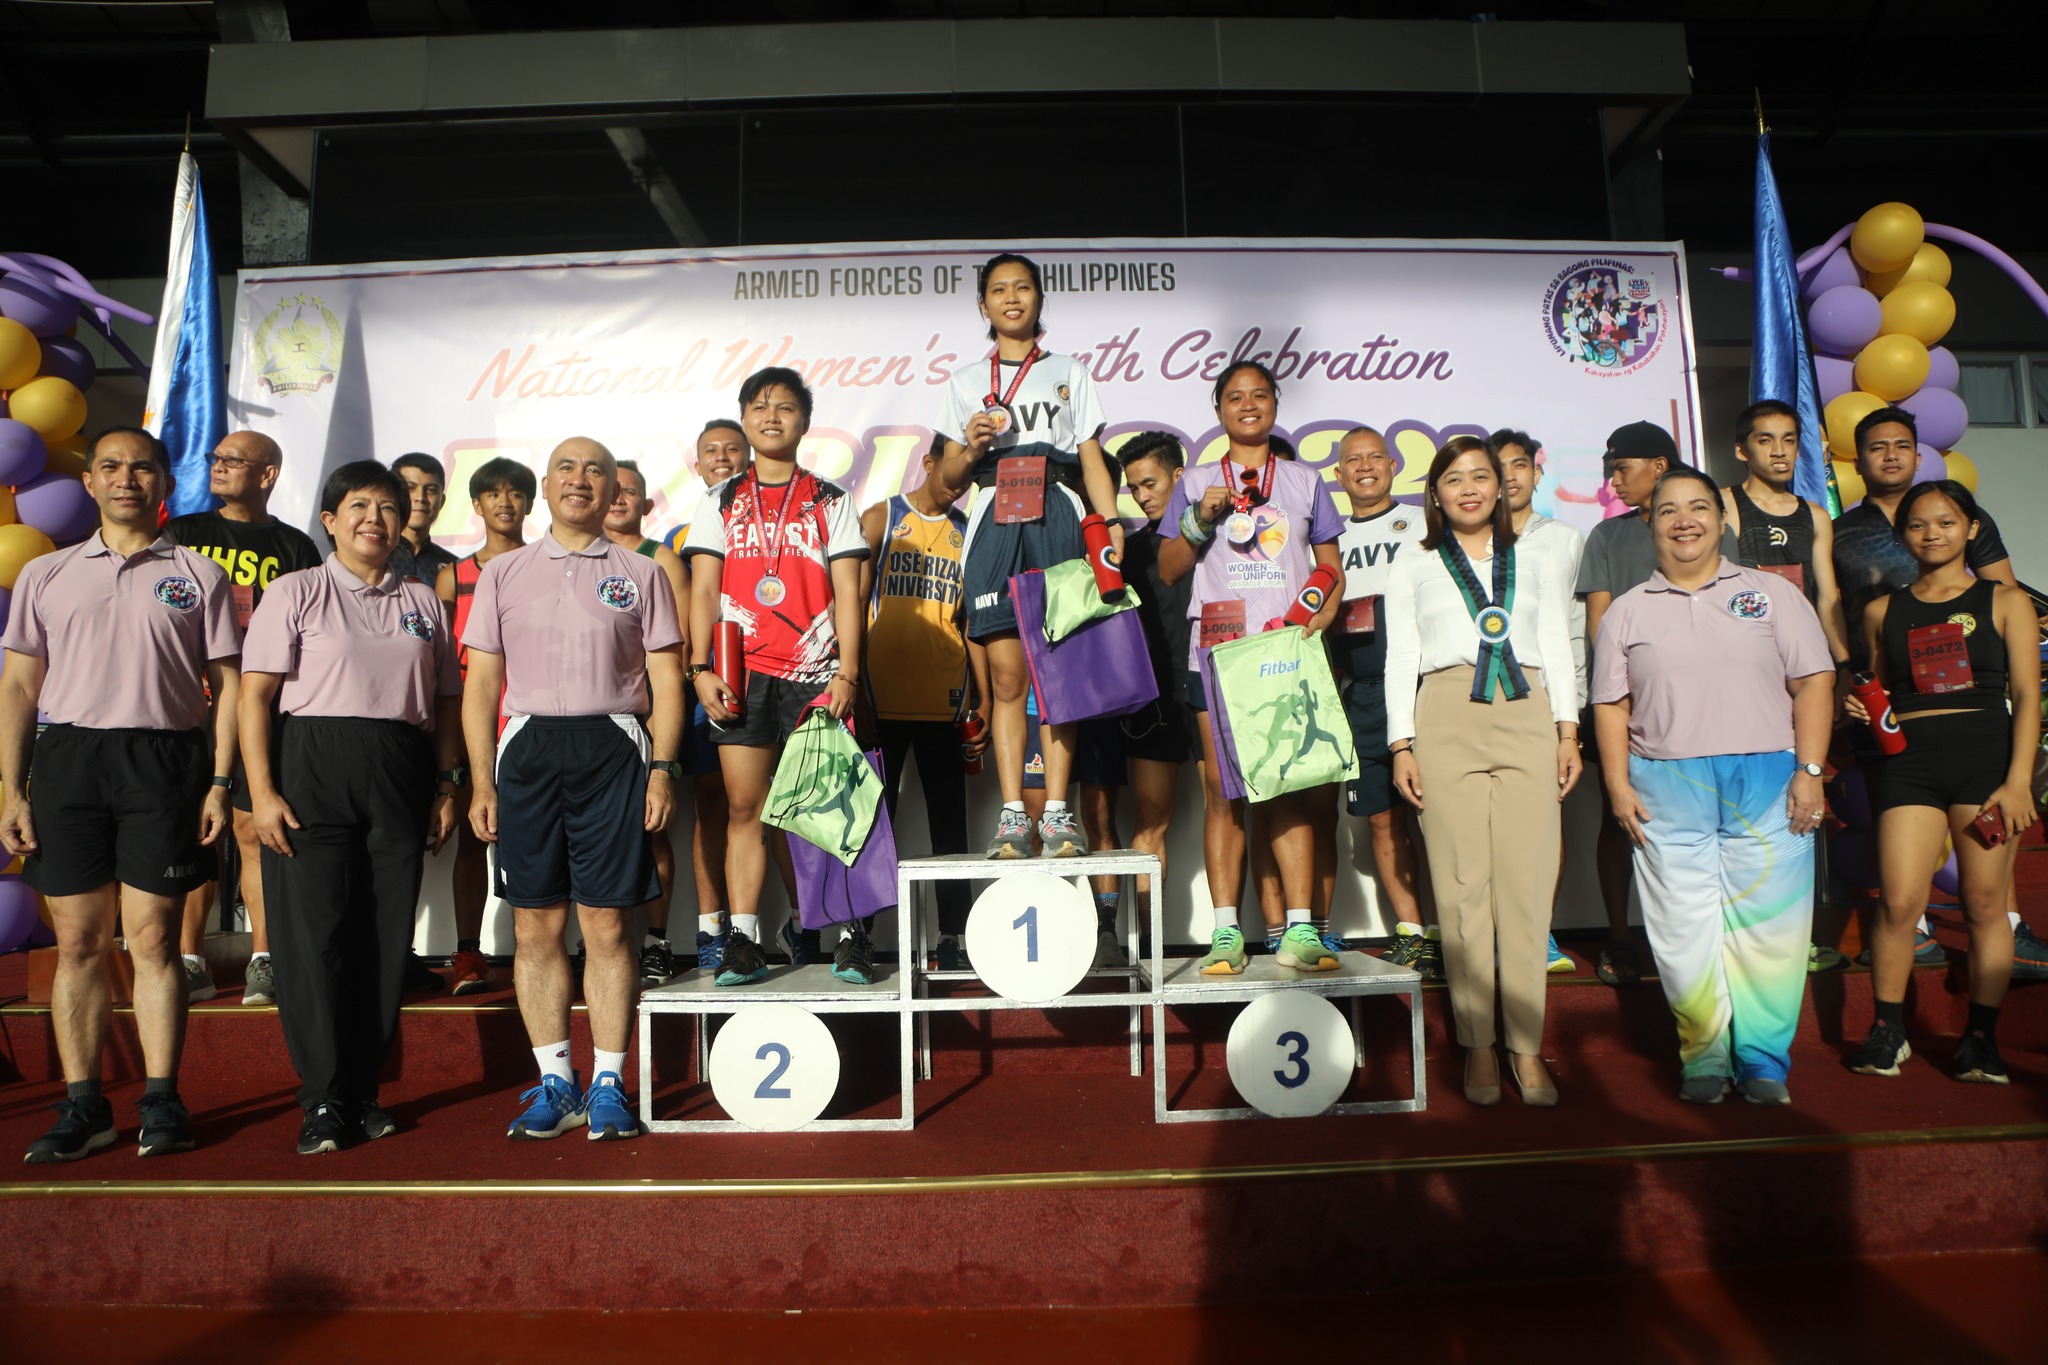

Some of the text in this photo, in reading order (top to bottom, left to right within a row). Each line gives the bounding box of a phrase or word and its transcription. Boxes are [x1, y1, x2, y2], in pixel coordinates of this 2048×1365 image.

[734, 269, 820, 300] ARMED
[830, 266, 923, 297] FORCES
[933, 265, 962, 294] OF
[1041, 262, 1176, 292] HILIPPINES
[1557, 259, 1590, 281] BAGONG
[1550, 279, 1561, 292] SA
[1542, 289, 1554, 315] PATAS
[1542, 316, 1566, 357] LIPUNANG
[467, 337, 709, 400] National
[1160, 326, 1454, 382] Celebration
[1009, 401, 1062, 433] AVY
[998, 477, 1043, 488] 3-0190
[733, 521, 819, 549] EARST
[734, 548, 763, 559] TRAC
[1340, 542, 1402, 571] AVY
[1227, 563, 1267, 573] WOMEN
[1228, 580, 1262, 588] OBSTACLE
[975, 591, 999, 610] NAVY
[1201, 622, 1244, 635] 3-0099
[1912, 641, 1964, 659] 3-0472
[1259, 658, 1302, 678] Fitbar
[1012, 905, 1038, 962] 1
[753, 1042, 791, 1099] 2
[1273, 1030, 1311, 1088] 3
